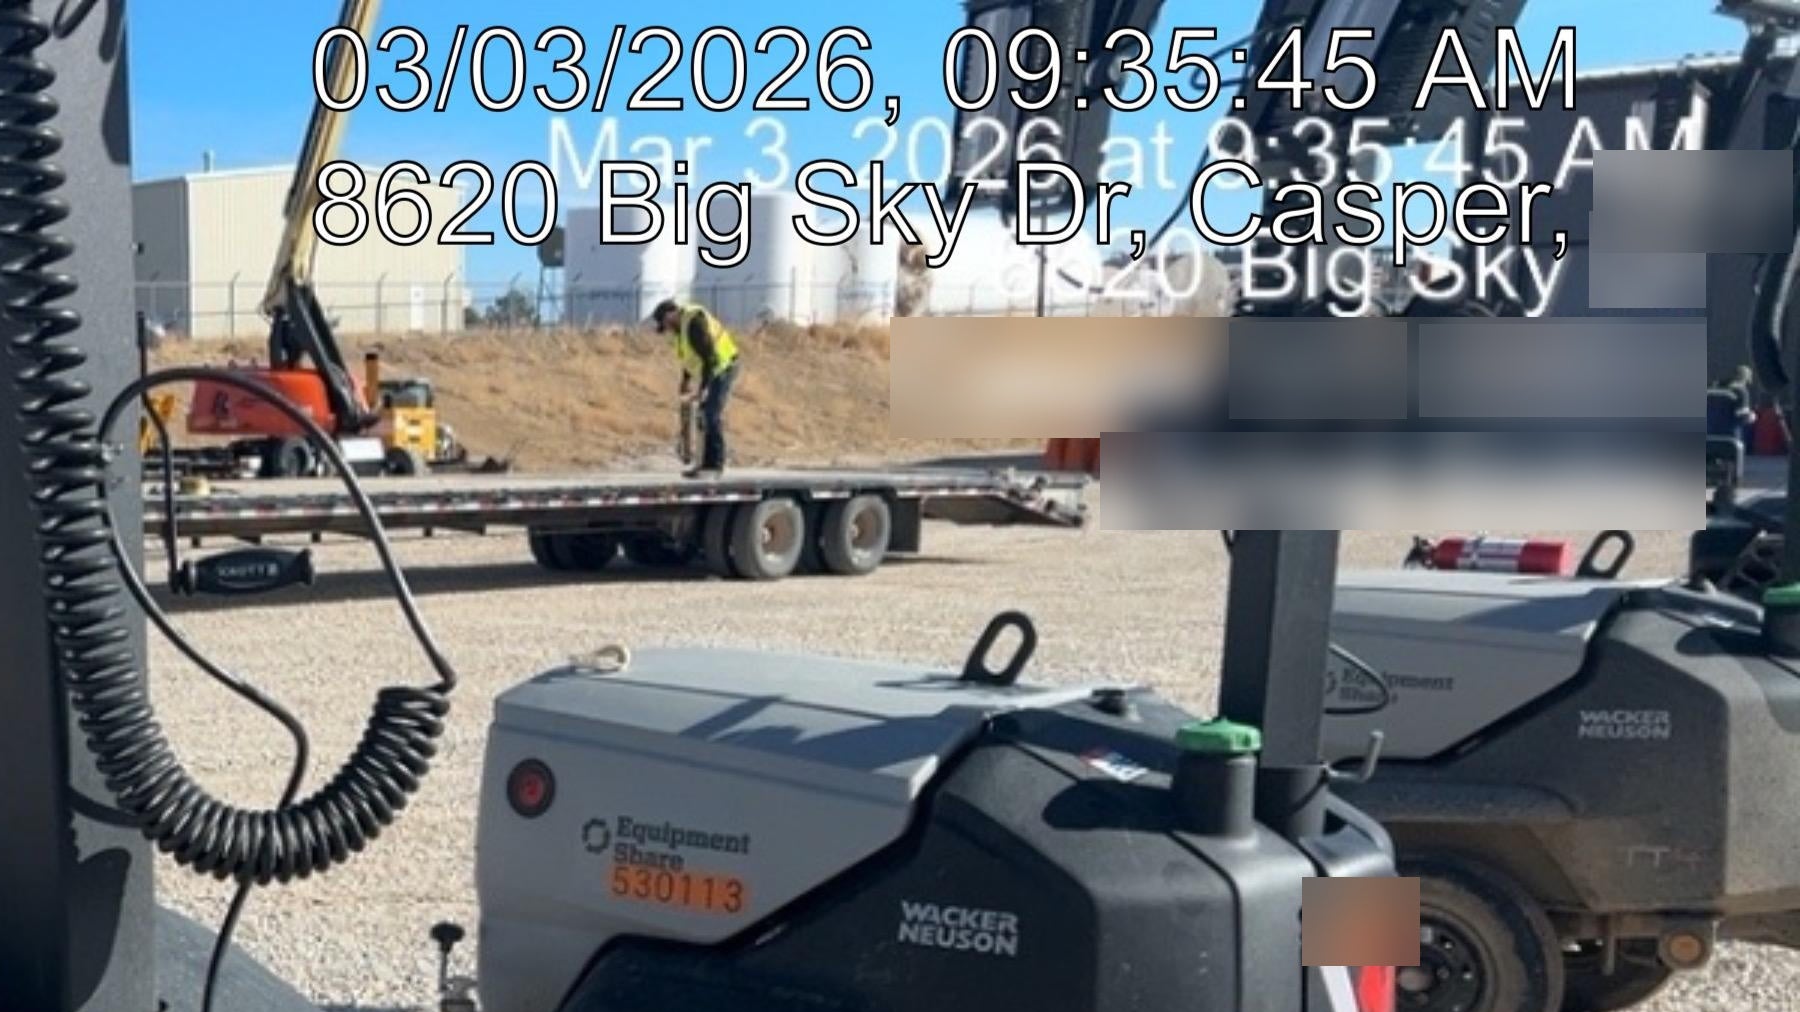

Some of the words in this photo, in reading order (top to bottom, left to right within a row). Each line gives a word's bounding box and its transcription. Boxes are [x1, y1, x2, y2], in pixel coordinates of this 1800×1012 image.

[616, 816, 750, 855] Equipment
[614, 842, 684, 871] Share
[612, 866, 743, 914] 530113
[901, 900, 1018, 934] WACKER
[898, 921, 1018, 956] NEUSON
